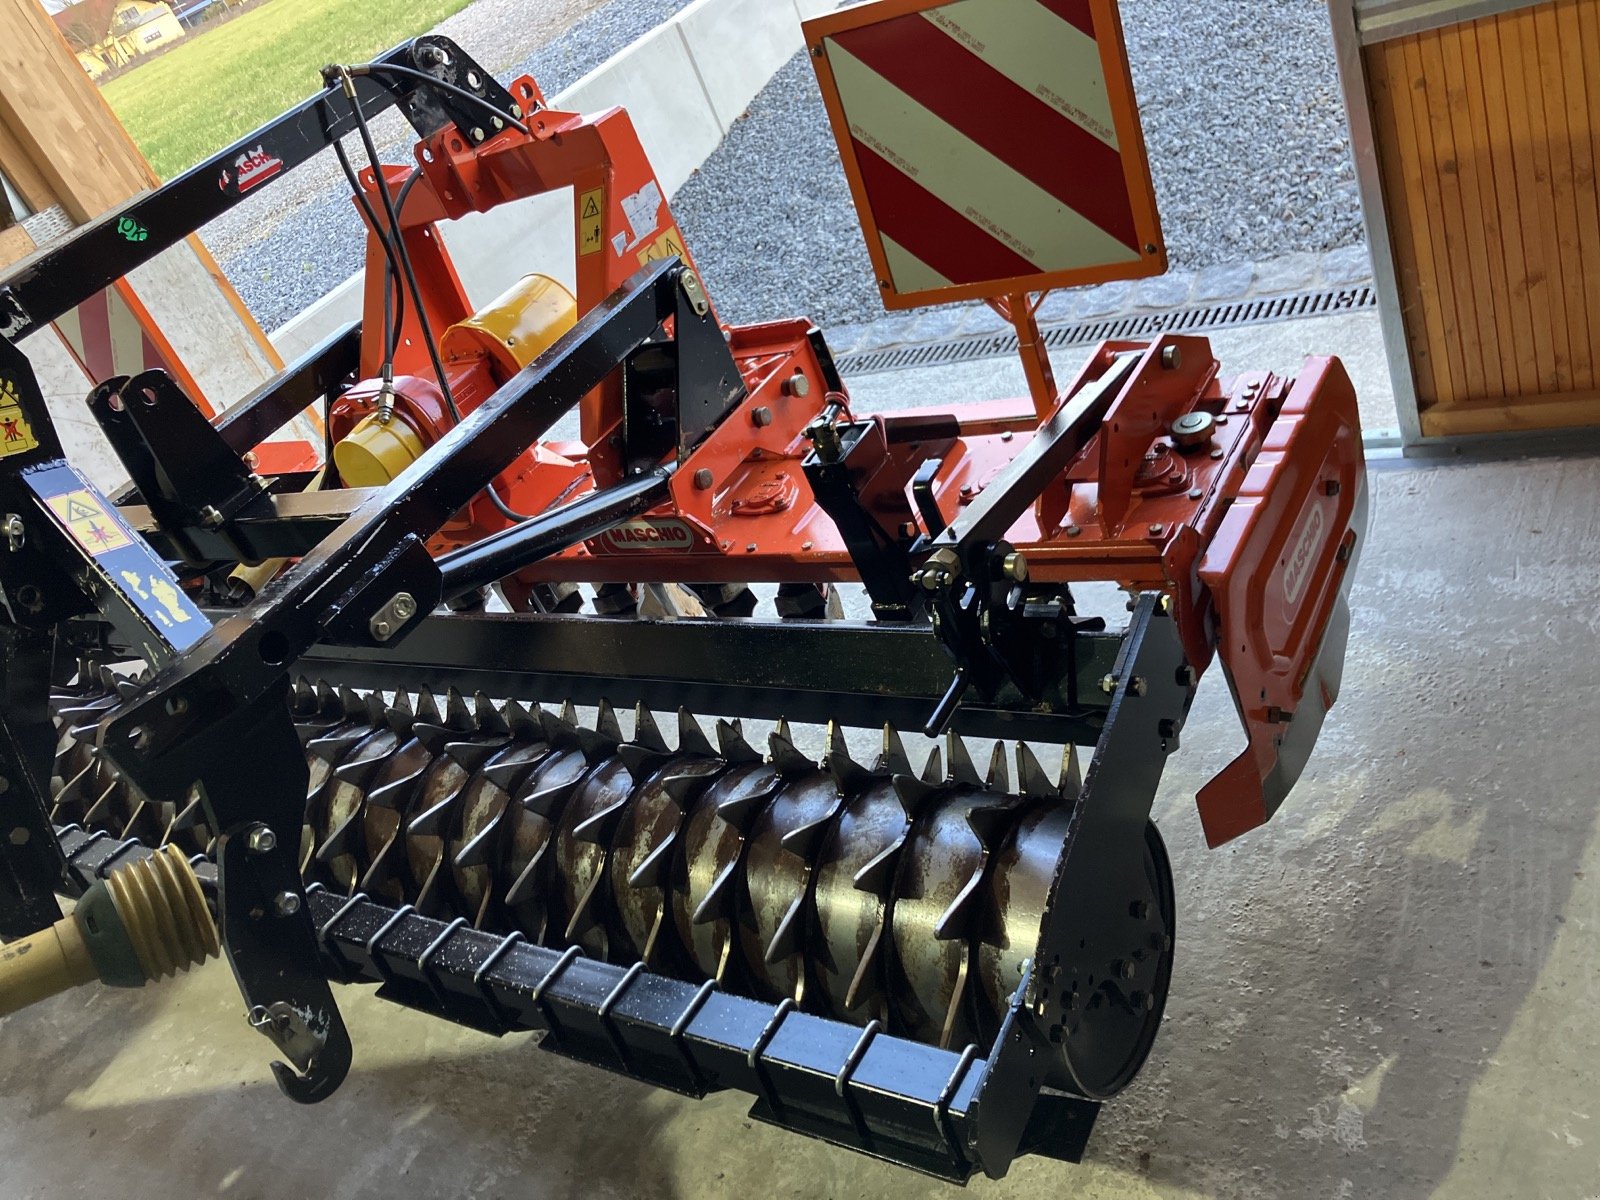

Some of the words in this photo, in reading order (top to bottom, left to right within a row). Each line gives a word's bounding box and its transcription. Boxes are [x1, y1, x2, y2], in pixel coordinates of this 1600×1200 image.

[121, 217, 148, 242] OK
[608, 526, 688, 543] MASCHIO
[1286, 509, 1321, 596] MASCHIO
